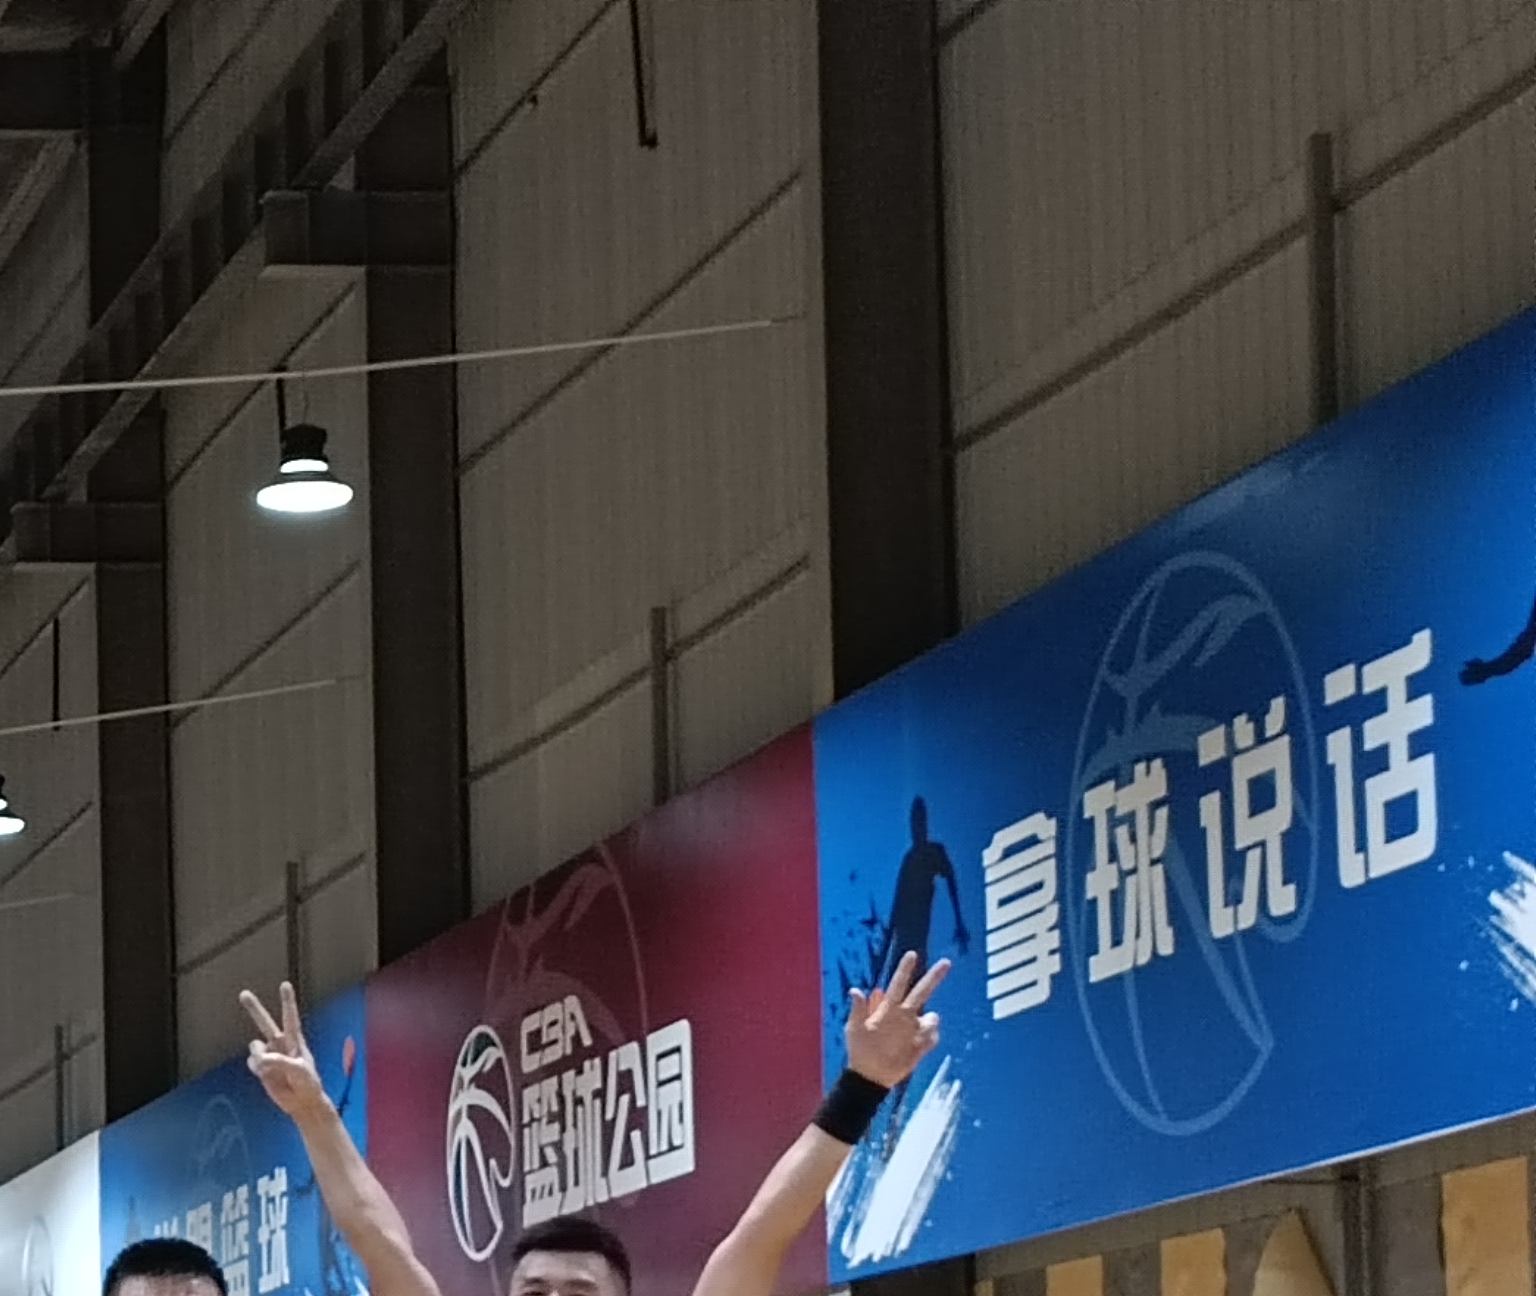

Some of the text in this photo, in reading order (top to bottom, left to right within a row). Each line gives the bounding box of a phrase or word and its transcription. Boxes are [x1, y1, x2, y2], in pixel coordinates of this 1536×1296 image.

[982, 627, 1439, 1021] 拿球说话
[521, 995, 593, 1074] CBA
[522, 1018, 696, 1229] 篮球公园
